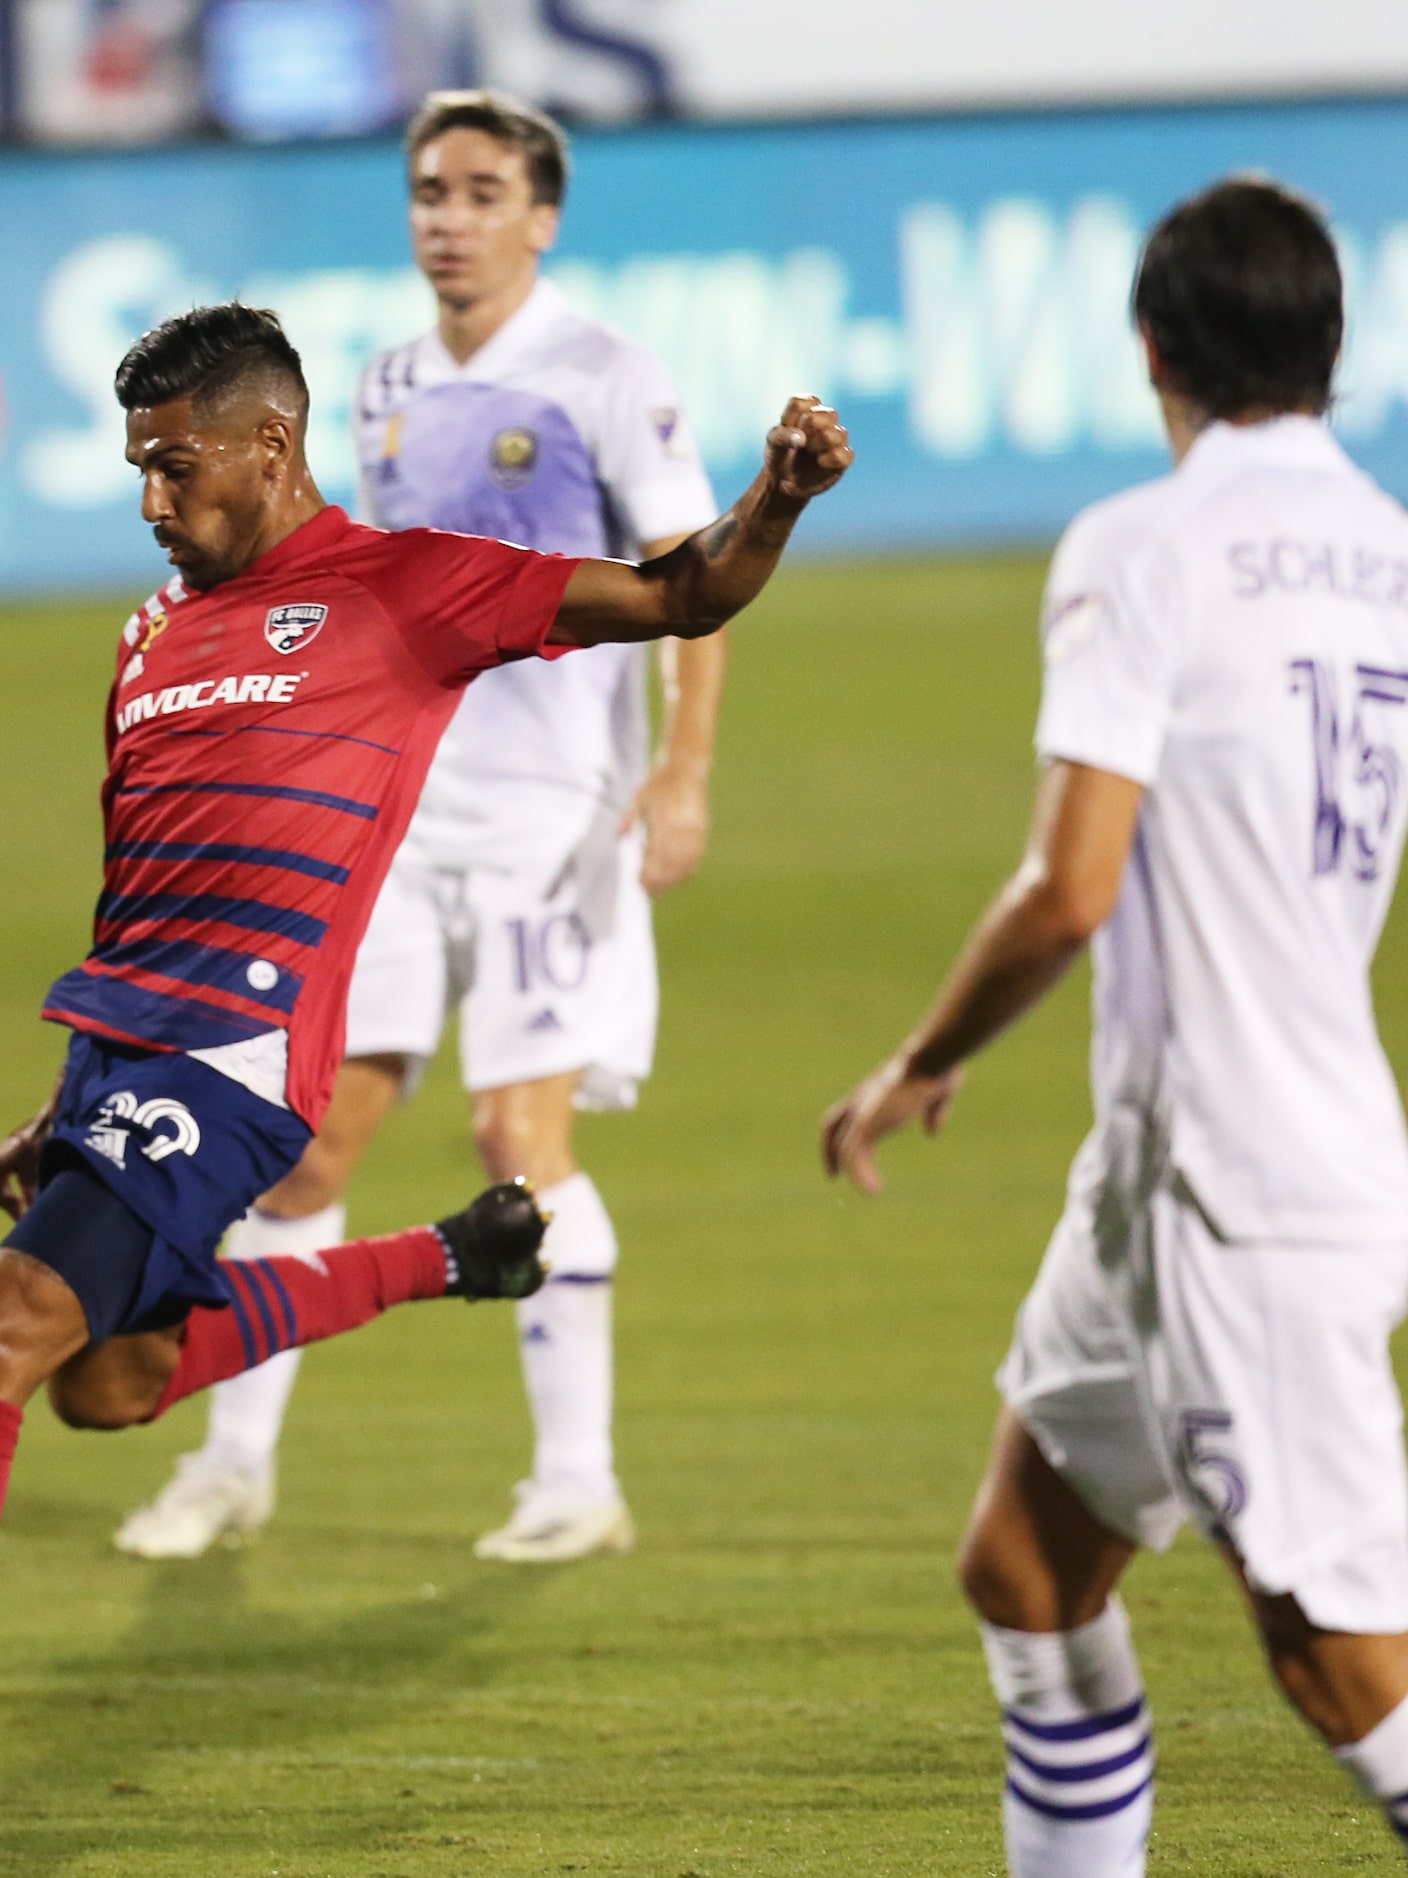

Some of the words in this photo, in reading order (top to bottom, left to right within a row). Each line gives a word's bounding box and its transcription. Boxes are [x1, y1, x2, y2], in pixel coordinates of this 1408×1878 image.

[1290, 655, 1408, 885] 15
[505, 913, 592, 993] 10
[1182, 1407, 1248, 1517] 5
